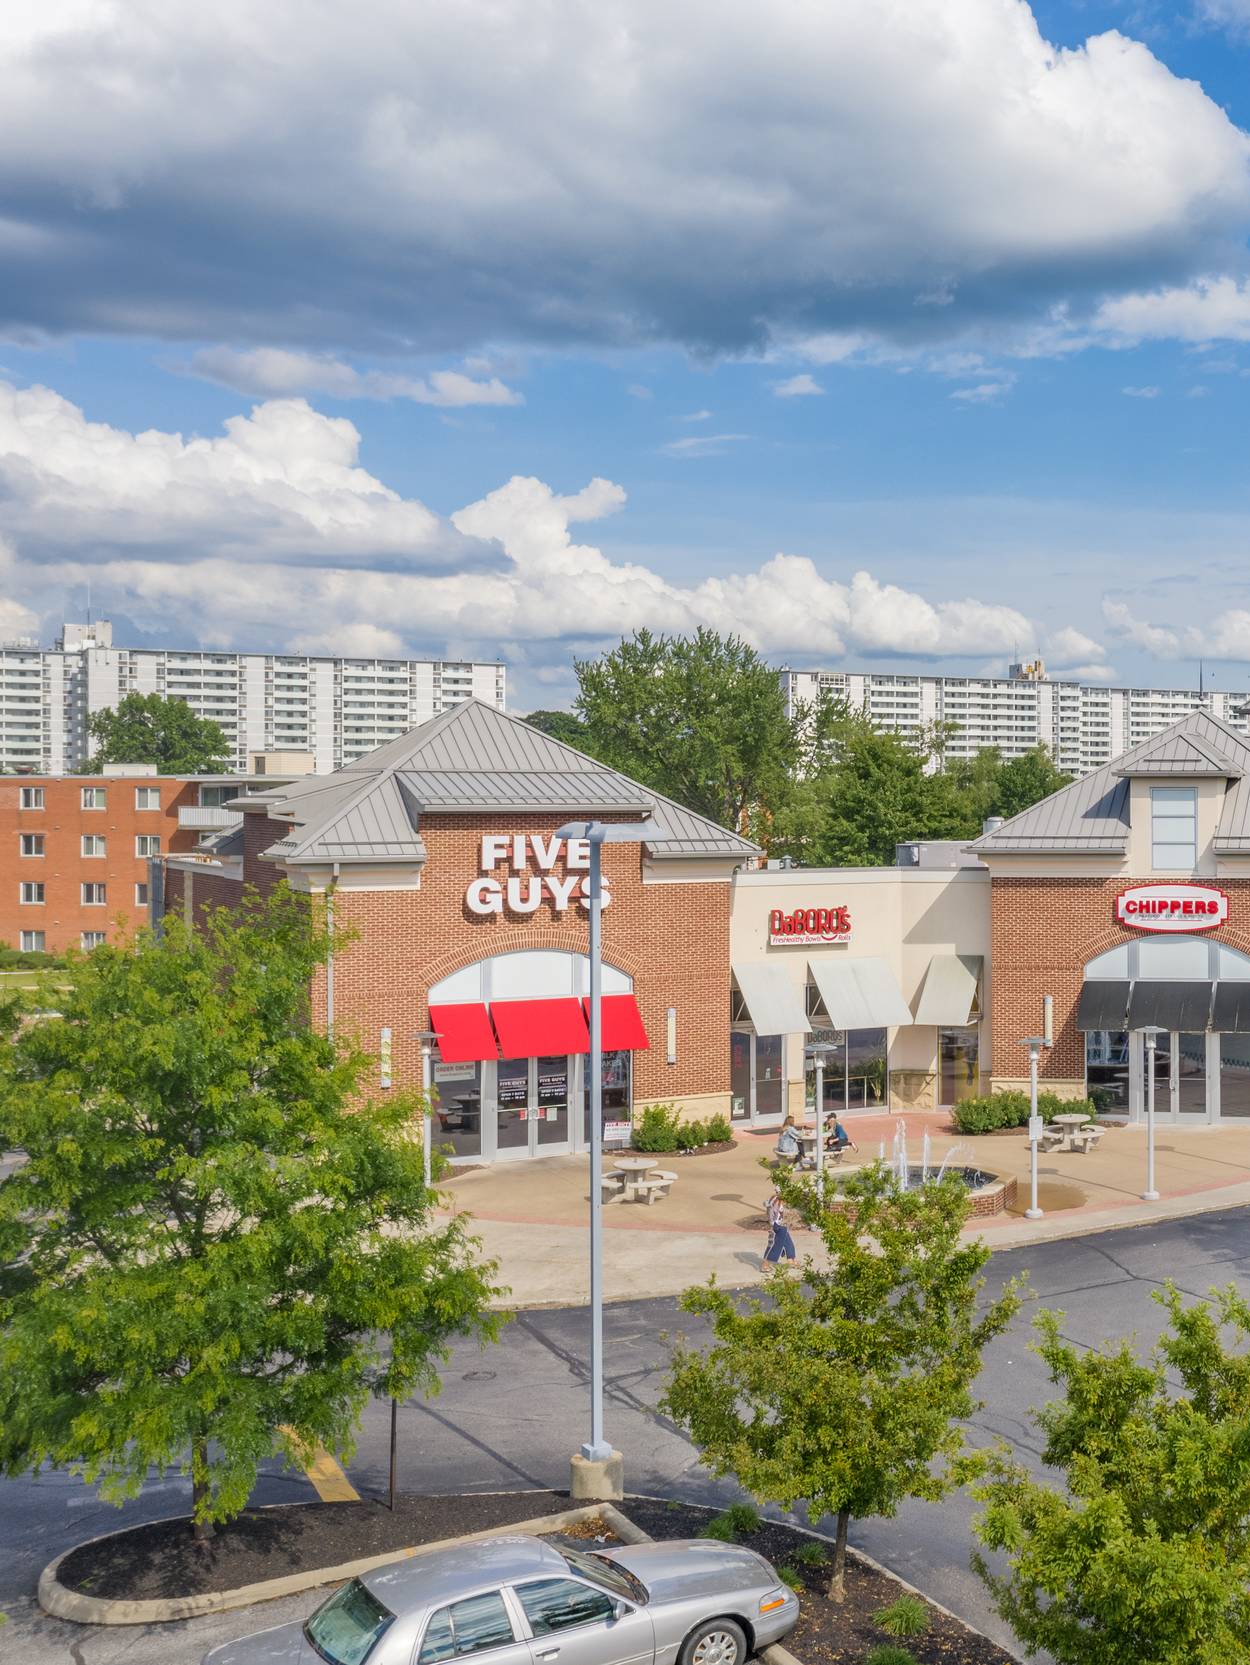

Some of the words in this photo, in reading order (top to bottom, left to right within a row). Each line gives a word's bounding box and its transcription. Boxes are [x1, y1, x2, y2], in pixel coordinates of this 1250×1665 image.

[481, 835, 591, 870] FIVE
[466, 876, 612, 914] GUYS
[1125, 900, 1219, 914] CHIPPERS
